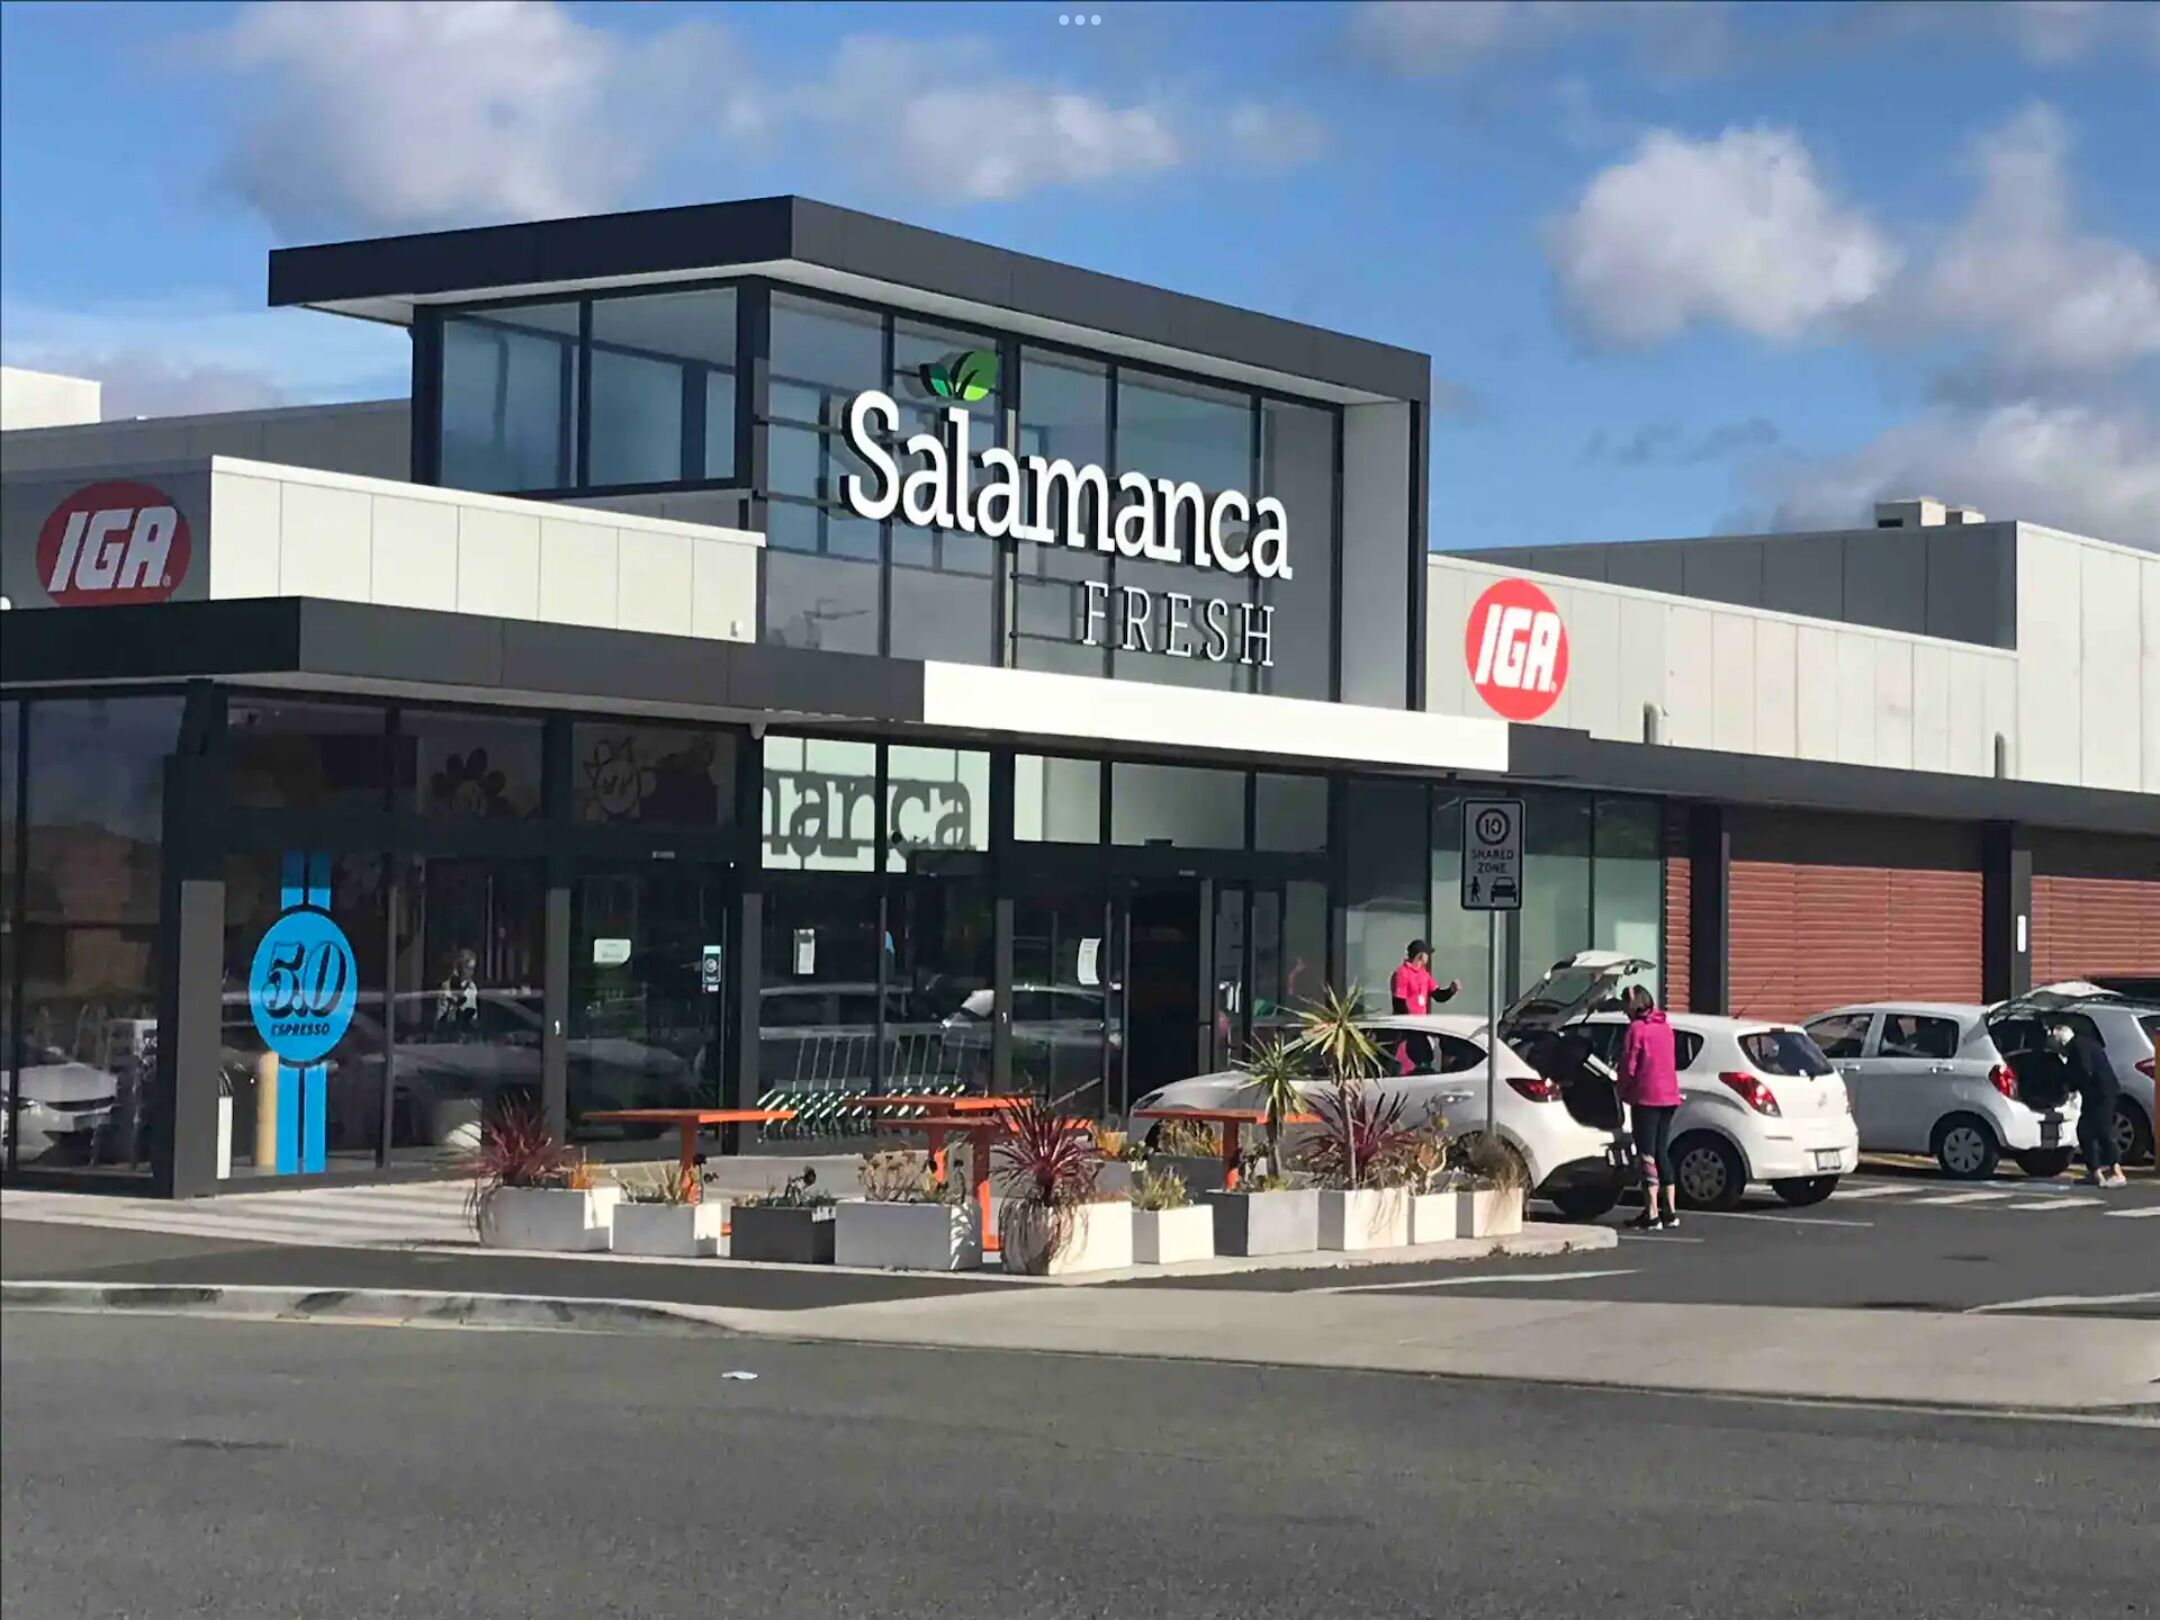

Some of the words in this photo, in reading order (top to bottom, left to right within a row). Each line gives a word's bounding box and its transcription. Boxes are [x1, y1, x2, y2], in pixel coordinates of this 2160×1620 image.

[846, 389, 1293, 581] Salamanca
[47, 506, 177, 592] IGA
[1081, 580, 1276, 667] FRESH
[1474, 603, 1561, 693] IGA
[1484, 818, 1503, 835] 10
[1471, 849, 1514, 860] SHARED
[1477, 862, 1507, 874] ZONE
[270, 1022, 330, 1036] ESPRESSO
